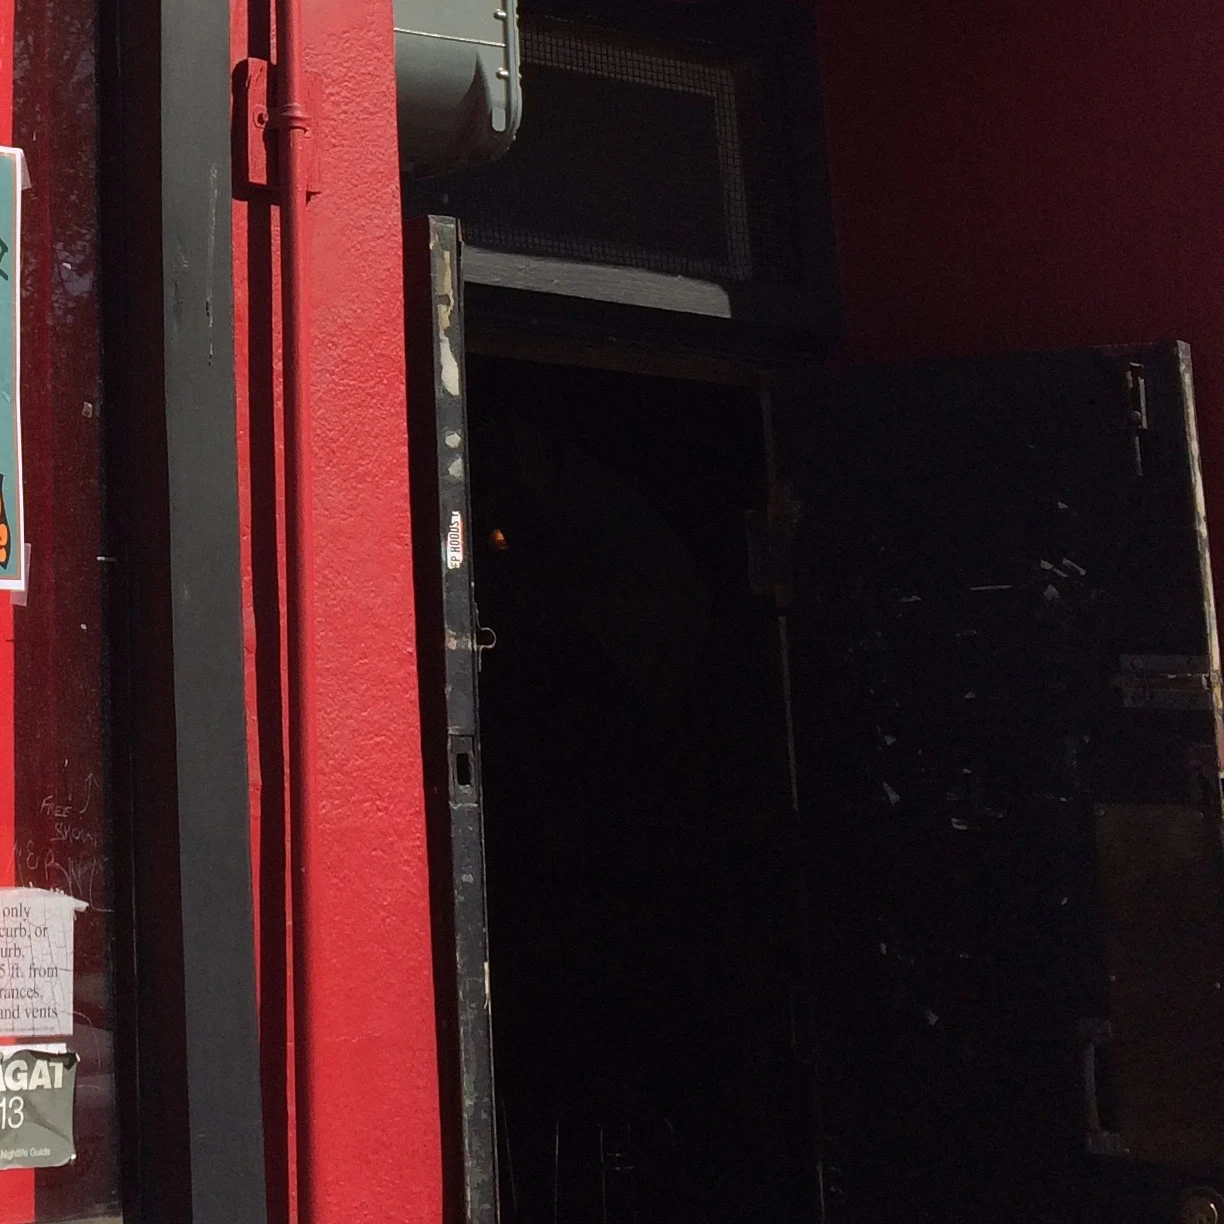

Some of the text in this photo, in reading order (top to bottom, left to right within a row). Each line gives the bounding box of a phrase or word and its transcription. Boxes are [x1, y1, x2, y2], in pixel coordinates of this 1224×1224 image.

[40, 794, 73, 818] FREE
[2, 902, 31, 922] only
[34, 926, 48, 937] or
[28, 962, 59, 978] from
[24, 1005, 58, 1020] vents
[0, 1147, 28, 1161] Nightlife
[29, 1146, 51, 1157] Guide
